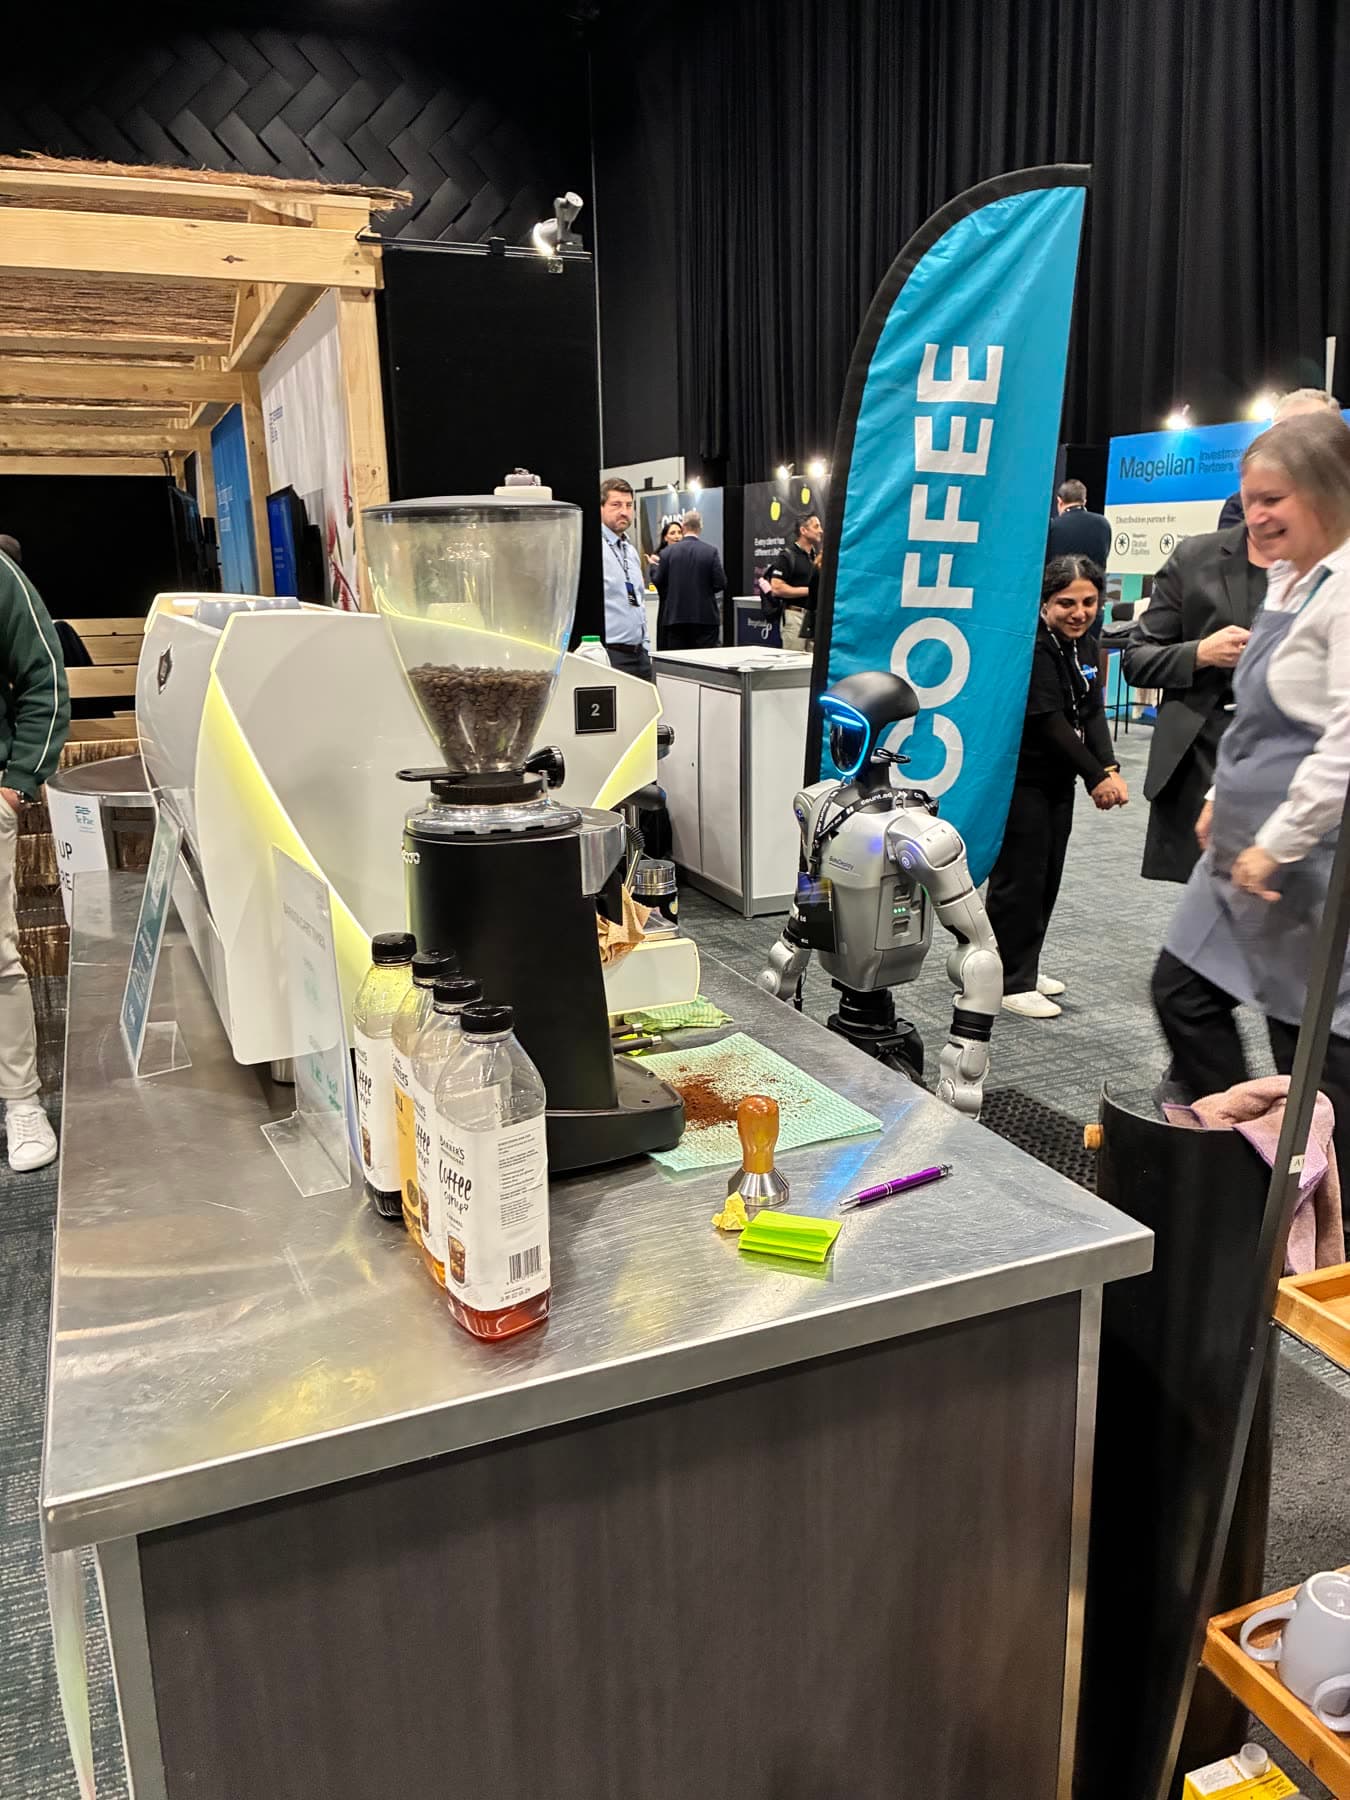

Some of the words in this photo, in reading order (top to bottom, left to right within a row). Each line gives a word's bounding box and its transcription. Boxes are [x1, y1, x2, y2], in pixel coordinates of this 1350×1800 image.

[1119, 453, 1195, 482] Magellan
[883, 343, 1004, 799] COFFEE
[591, 703, 600, 718] 2
[439, 1159, 472, 1201] Coffee
